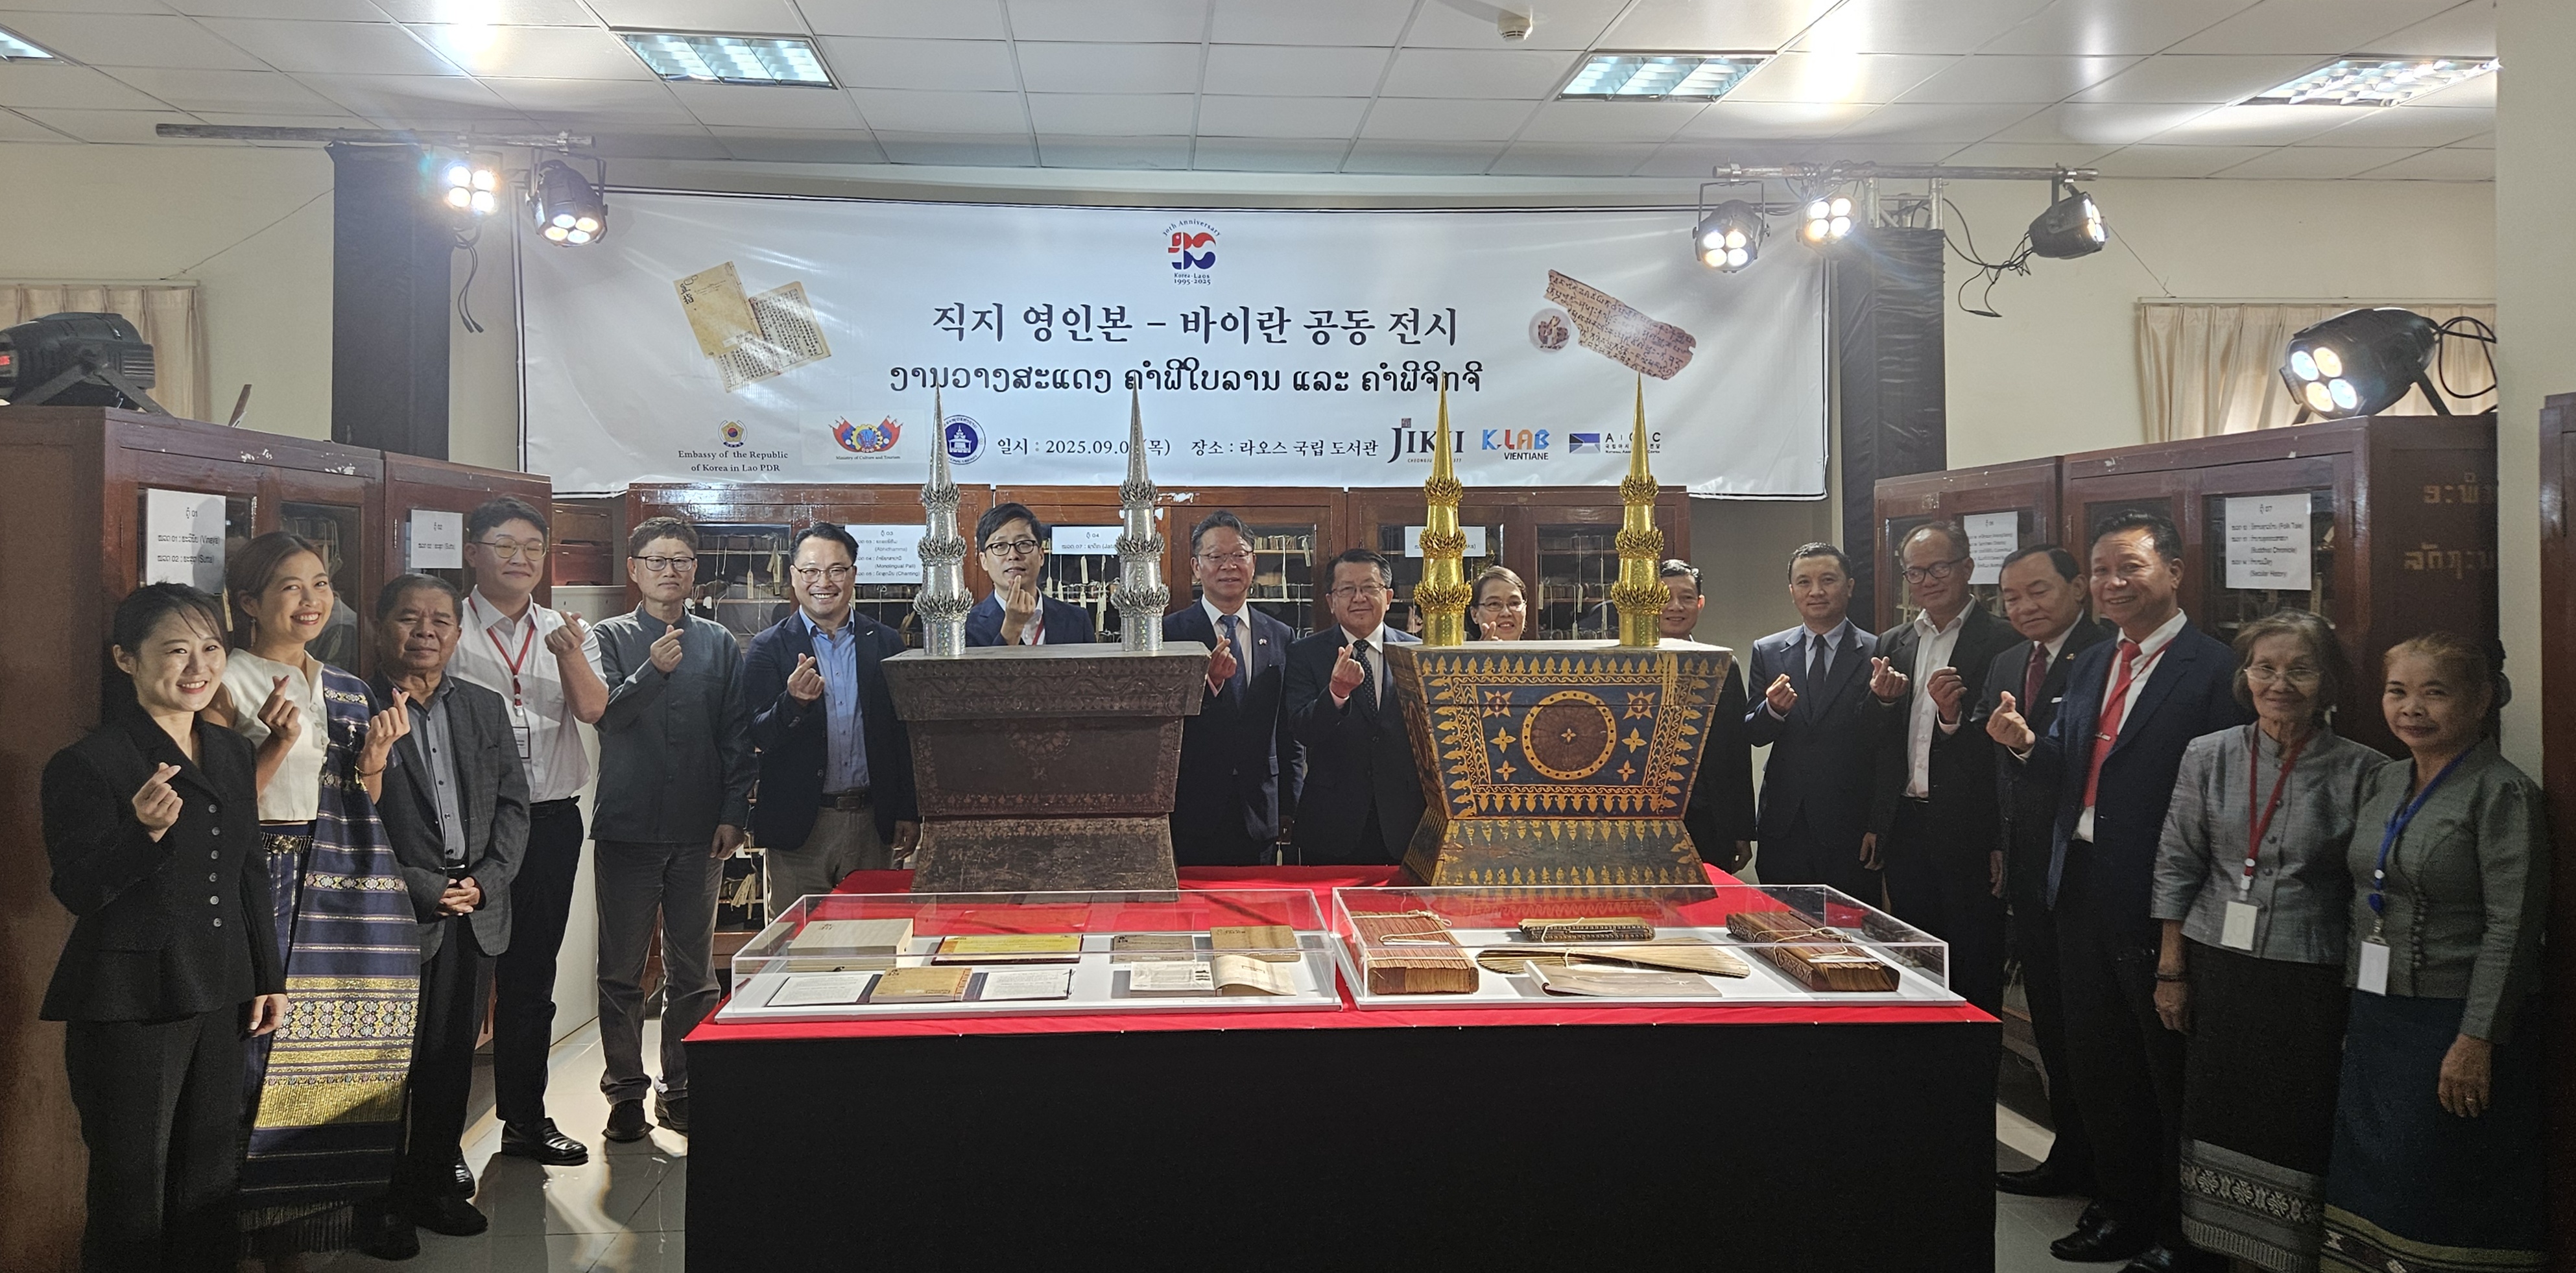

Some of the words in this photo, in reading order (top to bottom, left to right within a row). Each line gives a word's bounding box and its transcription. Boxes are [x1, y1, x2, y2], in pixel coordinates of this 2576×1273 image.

[1178, 219, 1221, 237] Anniversary
[933, 302, 1004, 342] 직지
[1023, 303, 1133, 342] 영인본
[1180, 305, 1292, 345] 바이란
[1303, 310, 1376, 346] 공동
[1388, 307, 1457, 346] 전시
[890, 366, 1112, 394] ງານວາງສະແດງ
[1293, 370, 1350, 392] ແລະ
[678, 451, 716, 460] Embassy
[750, 451, 789, 460] Republic
[997, 438, 1028, 455] 일시
[1045, 438, 1171, 456] 2025.09.0목)
[1191, 439, 1224, 456] 장소
[1239, 439, 1288, 456] 라오스
[1293, 439, 1324, 457] 국립
[1330, 439, 1379, 457] 도서관
[1387, 427, 1465, 463] JIKI
